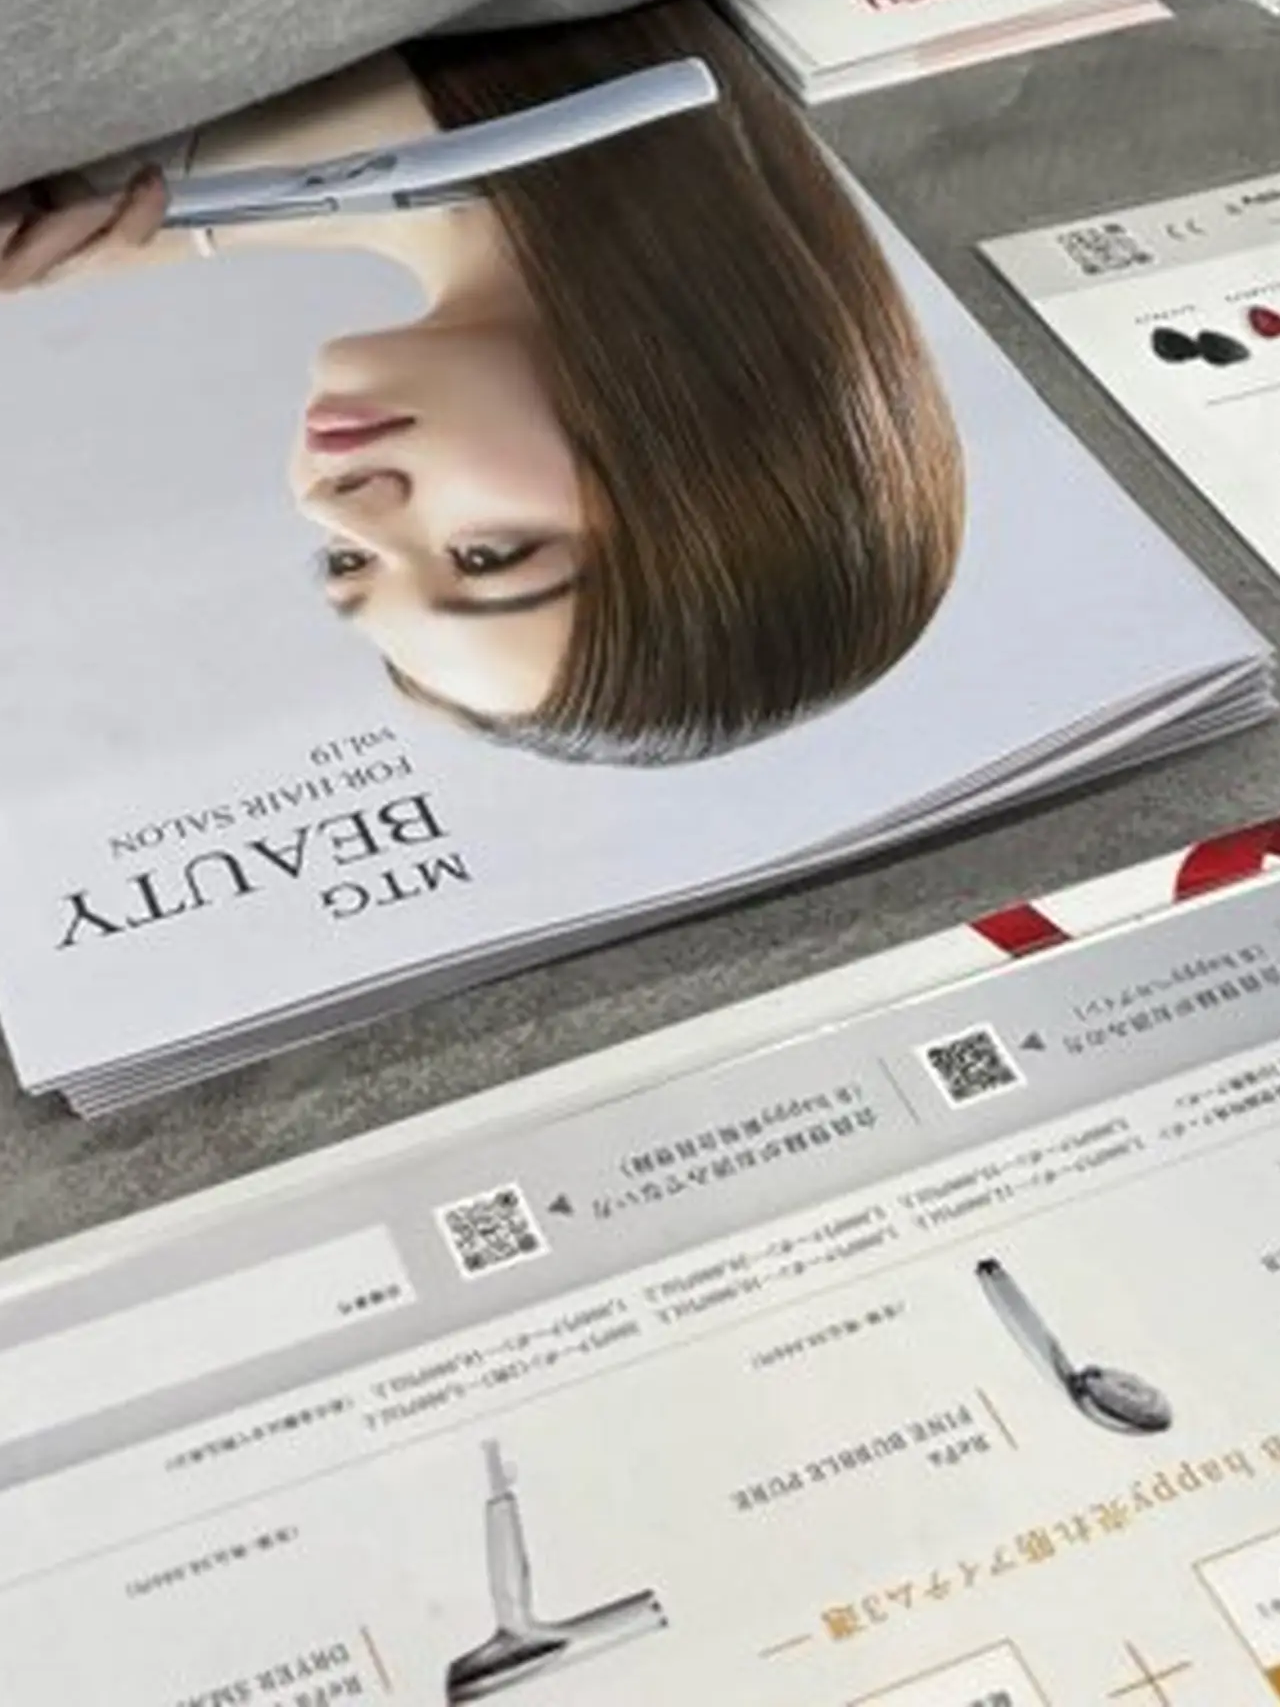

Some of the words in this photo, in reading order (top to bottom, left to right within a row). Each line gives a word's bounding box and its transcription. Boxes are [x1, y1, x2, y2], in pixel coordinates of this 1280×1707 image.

[341, 756, 412, 788] FOR
[241, 777, 334, 818] HAIR
[110, 805, 235, 857] SALON
[59, 795, 444, 948] BEAUTY
[320, 851, 471, 919] MTG
[257, 1644, 349, 1690] DRYER
